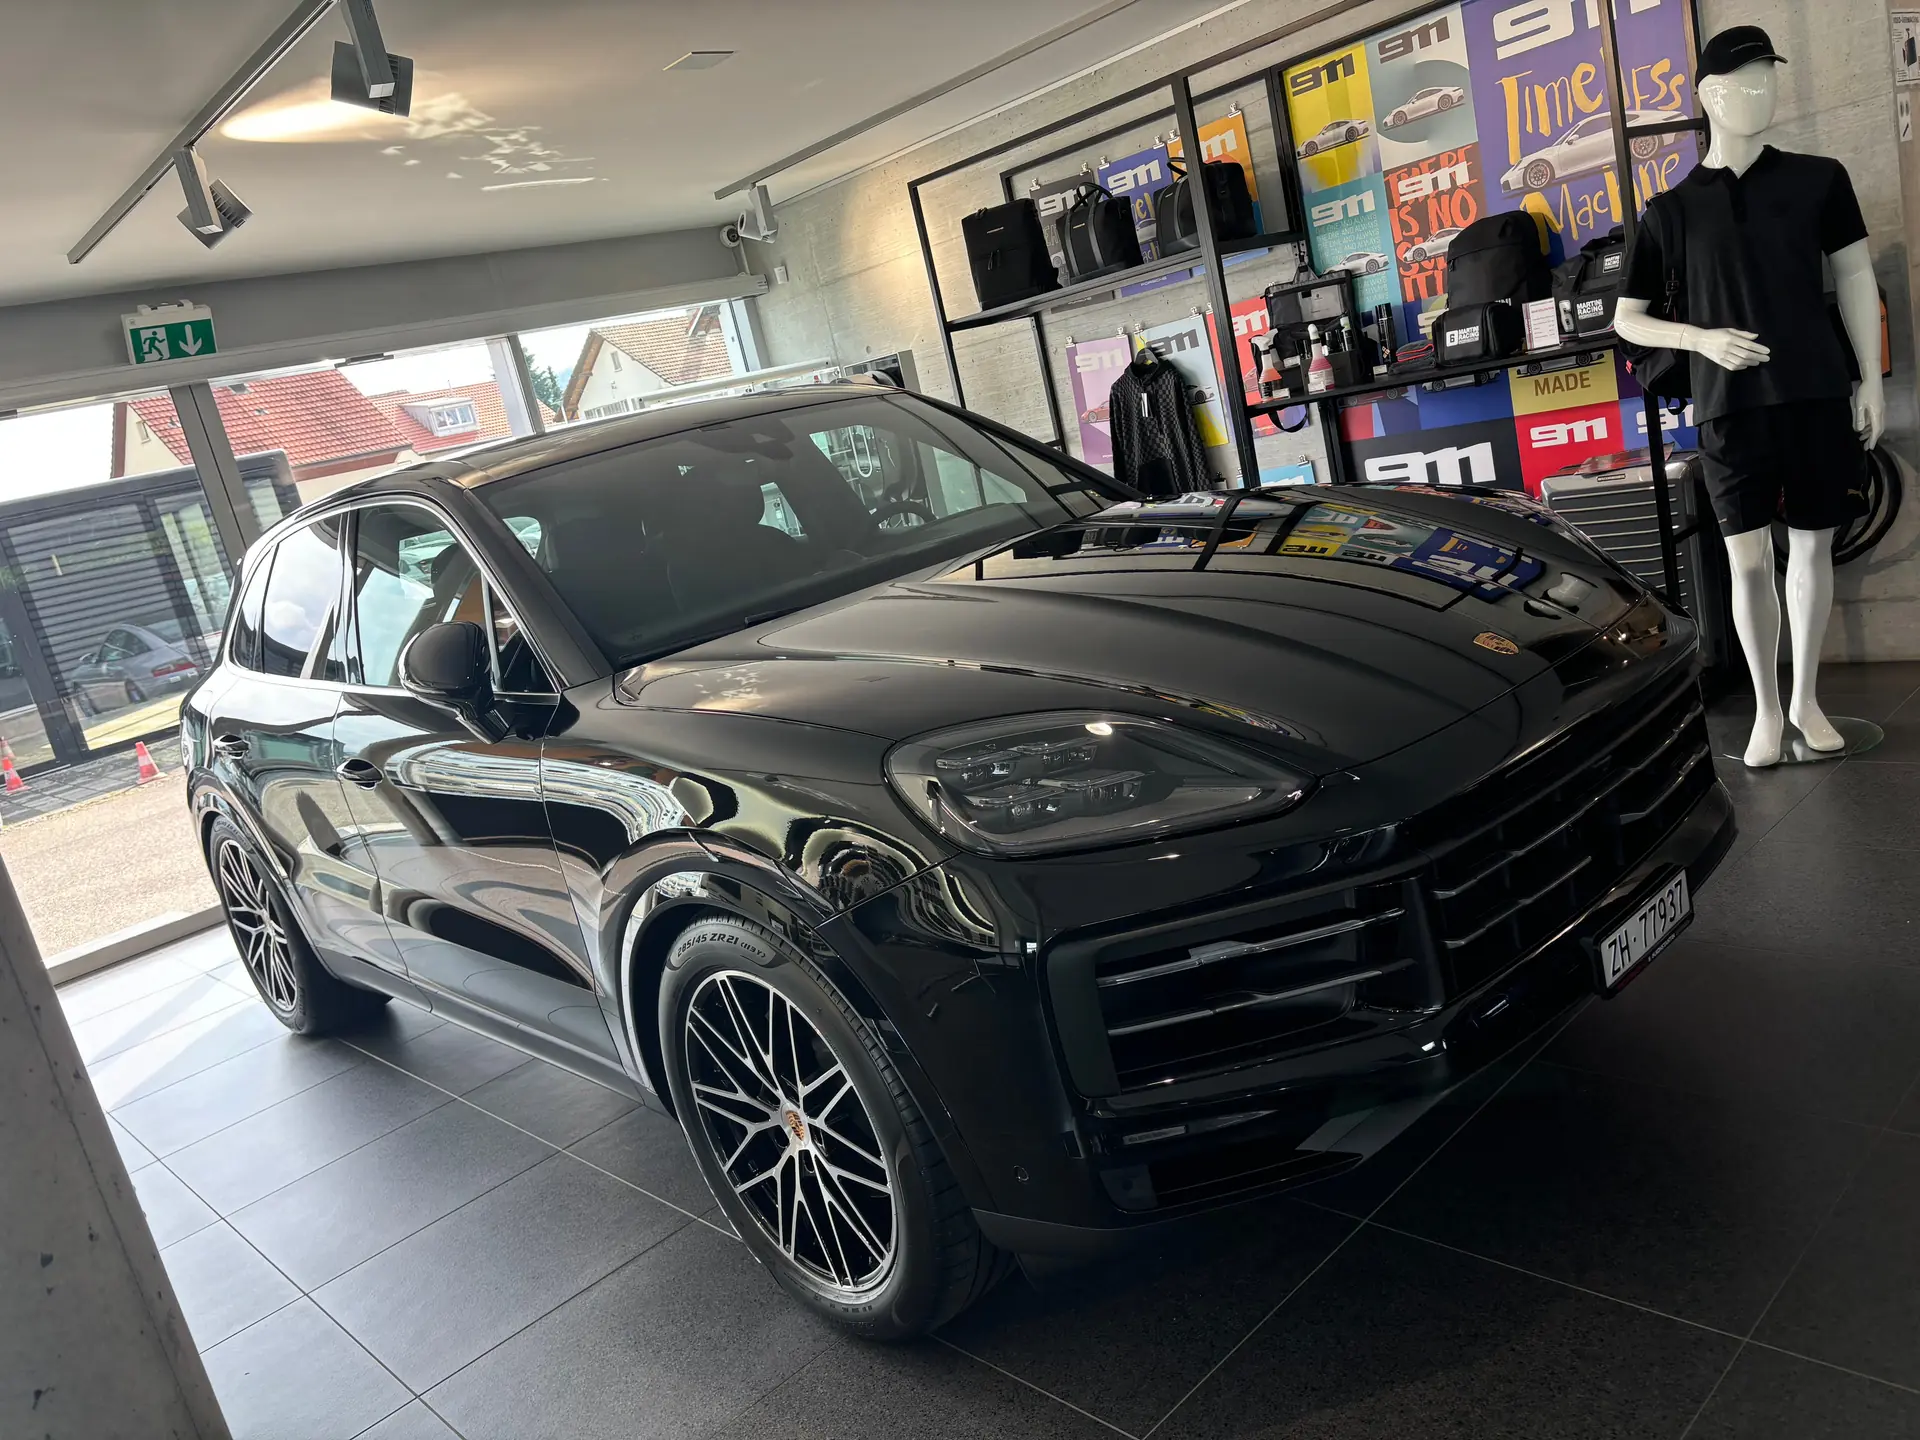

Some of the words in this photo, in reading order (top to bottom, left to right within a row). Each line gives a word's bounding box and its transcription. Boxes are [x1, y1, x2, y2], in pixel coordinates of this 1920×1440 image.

[1378, 15, 1450, 65] 911
[1290, 52, 1356, 97] 911
[1107, 159, 1162, 196] 911
[1398, 160, 1470, 203] 911
[1311, 189, 1376, 228] 911
[1388, 204, 1420, 244] IS
[1427, 187, 1478, 236] NO
[1576, 299, 1603, 310] MARTINI
[1577, 305, 1603, 316] RACING
[1458, 331, 1480, 341] RACING
[1075, 349, 1124, 373] 911
[1534, 371, 1592, 397] MADE
[1530, 417, 1609, 449] 911
[1364, 441, 1496, 485] 911
[677, 933, 708, 958] 285/45
[1607, 929, 1632, 978] ZH
[1638, 879, 1684, 949] 77937
